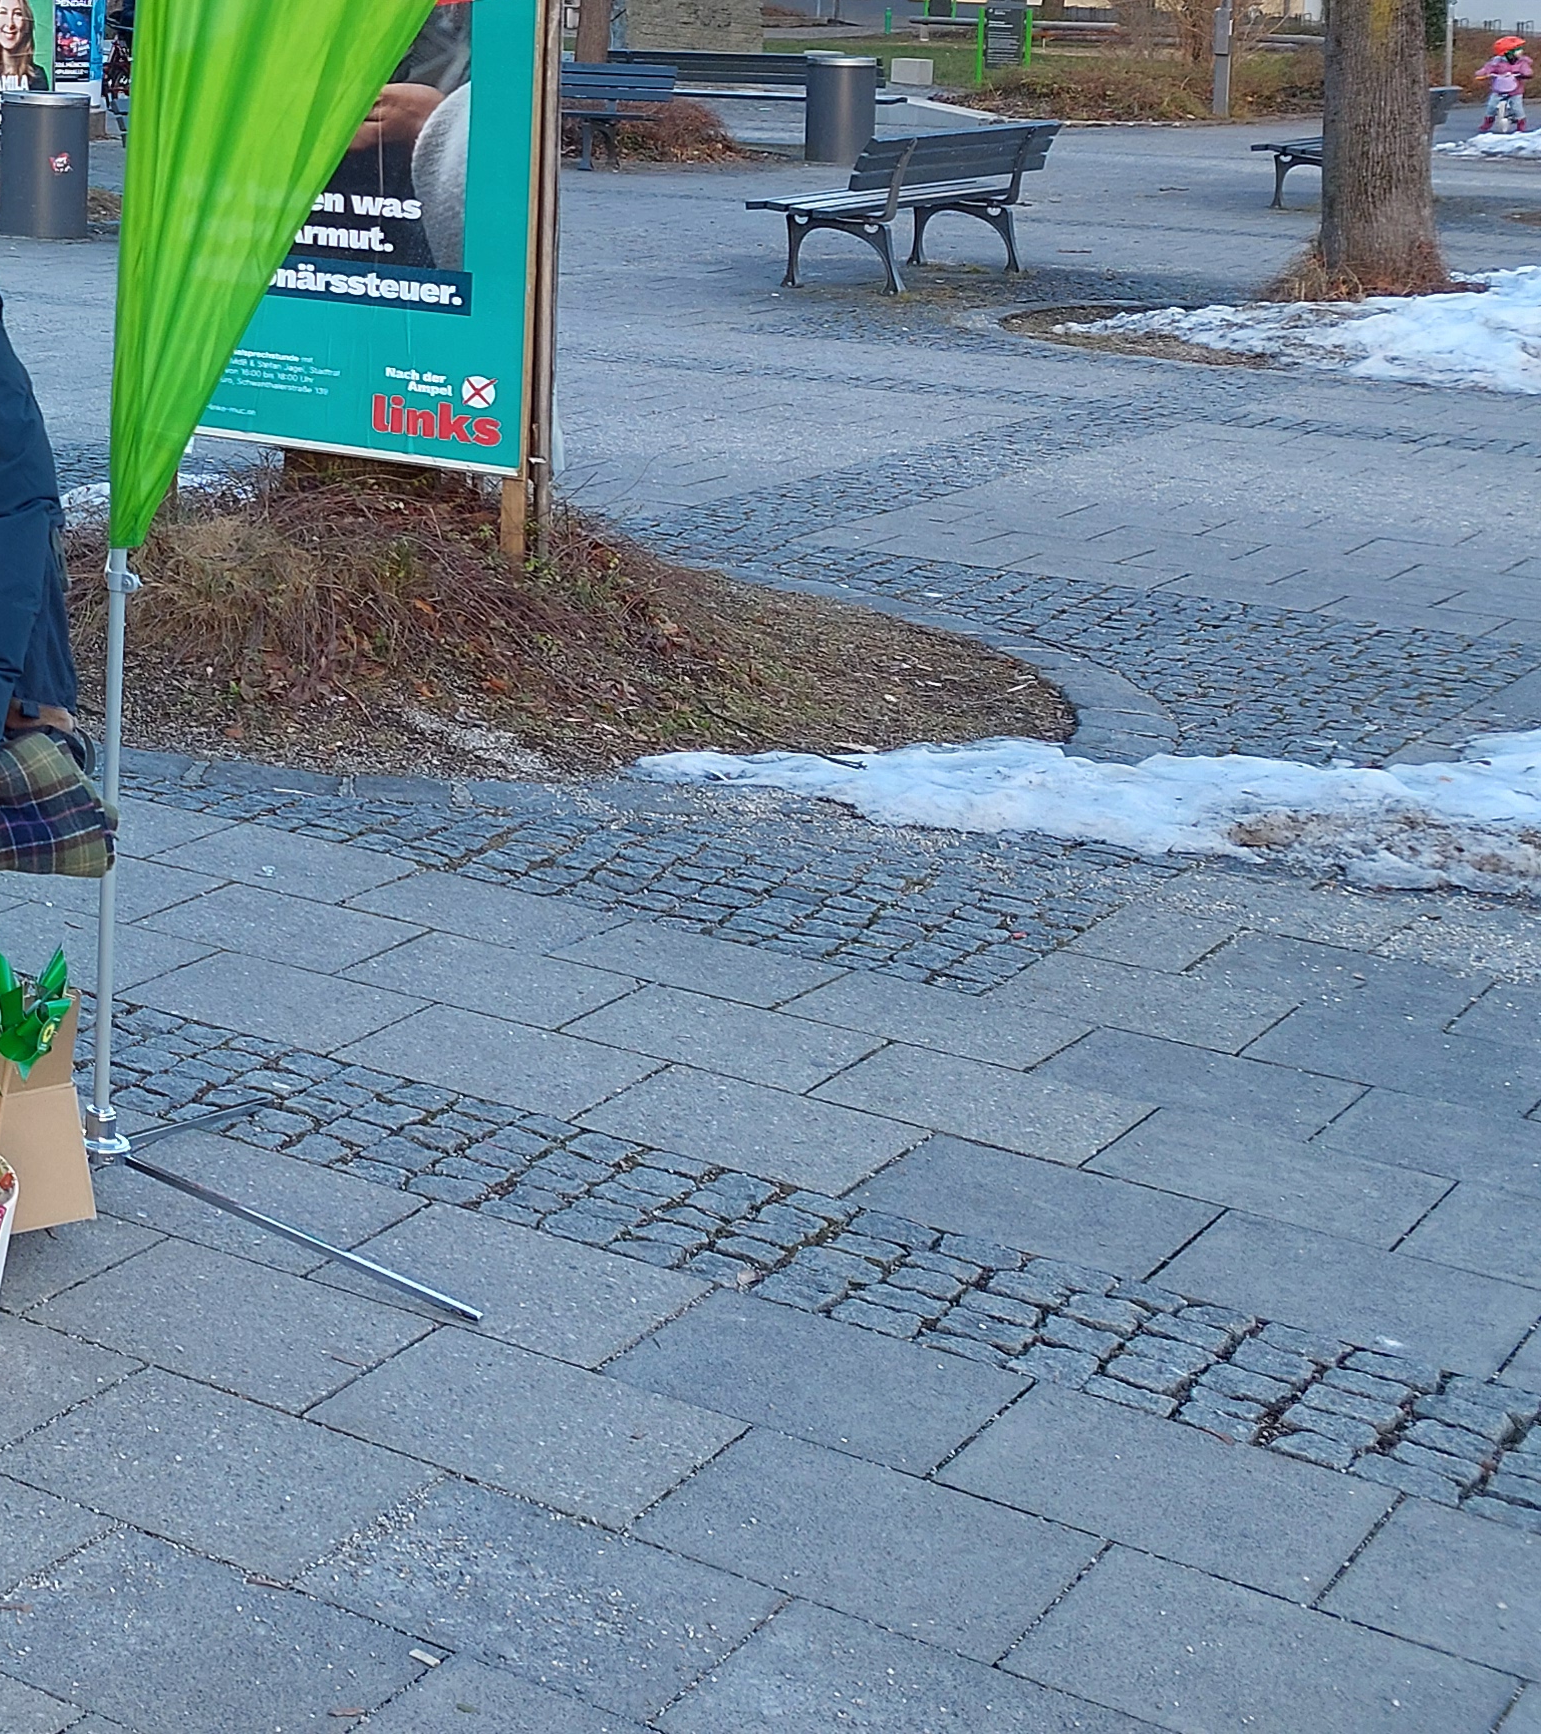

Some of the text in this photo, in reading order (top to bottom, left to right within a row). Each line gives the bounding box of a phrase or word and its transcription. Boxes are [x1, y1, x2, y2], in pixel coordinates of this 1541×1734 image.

[310, 191, 423, 220] en was
[267, 263, 464, 306] onärssteuer.
[384, 366, 447, 384] Nach der
[407, 380, 454, 397] Ampel
[371, 393, 503, 448] links
